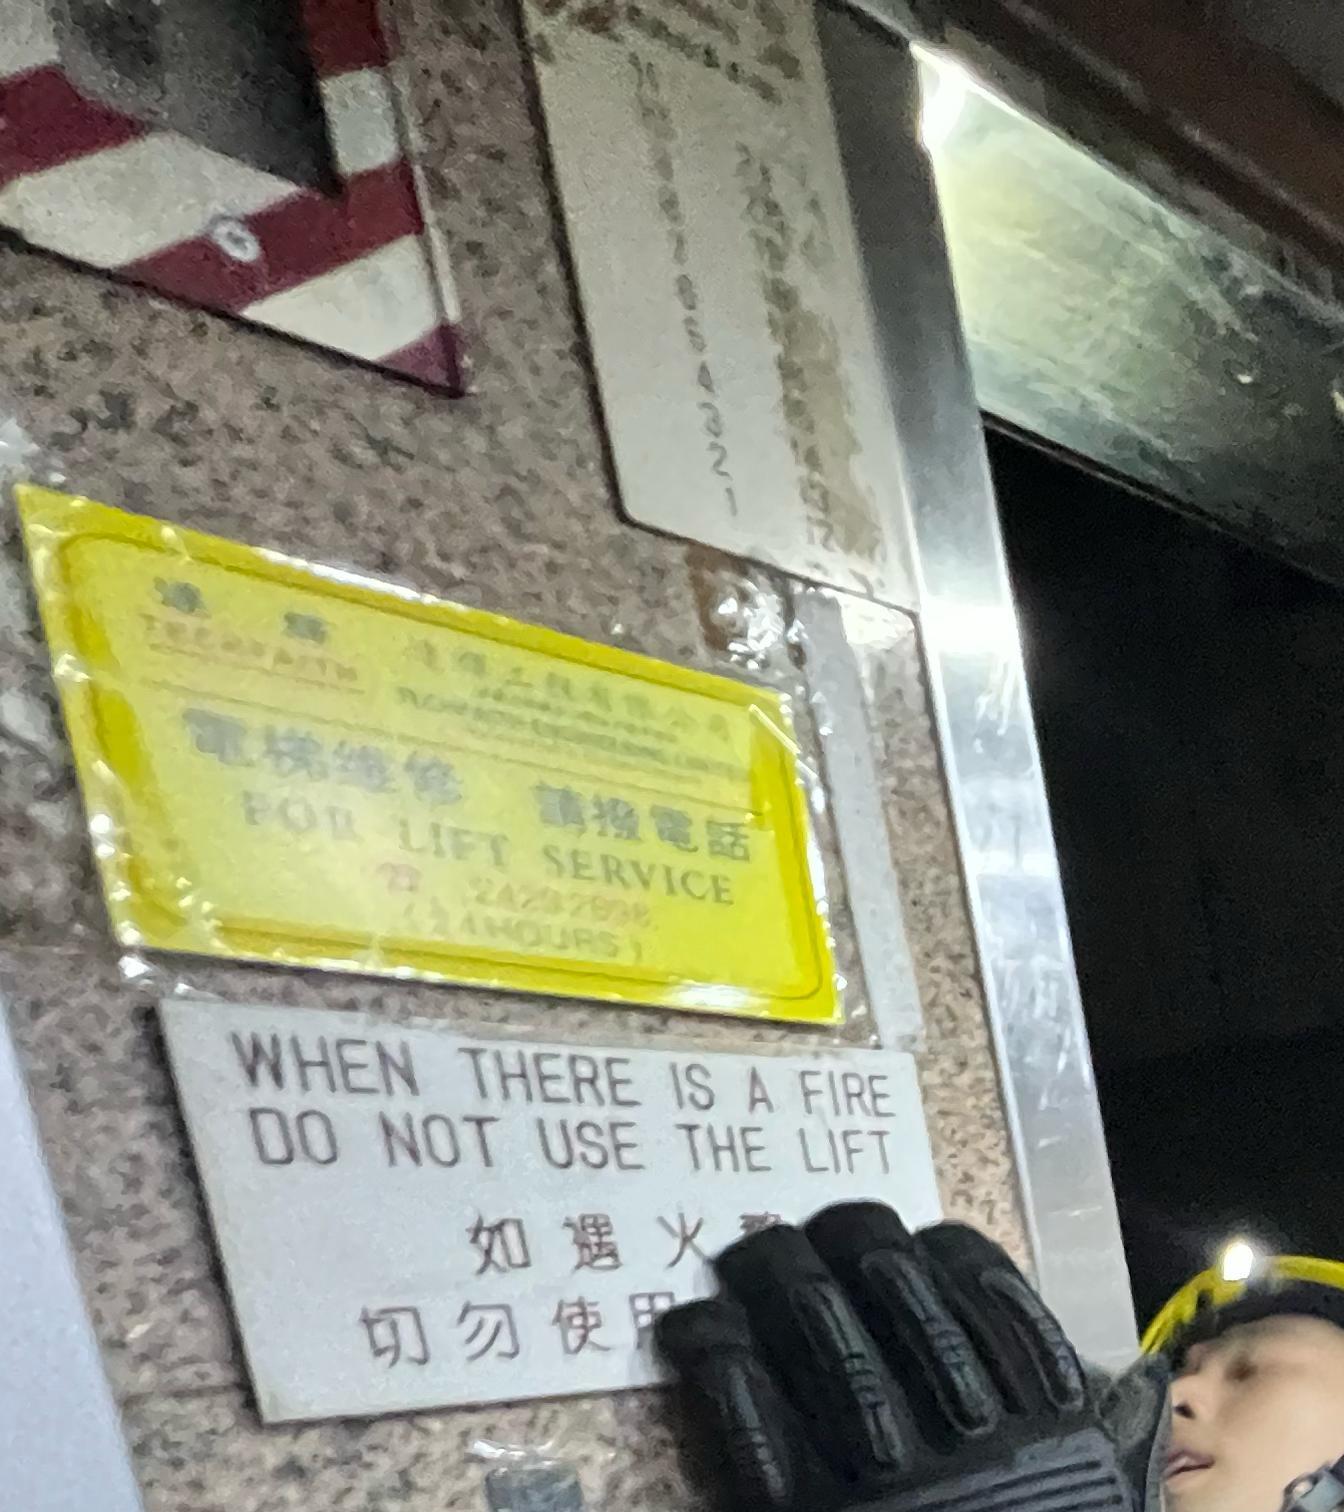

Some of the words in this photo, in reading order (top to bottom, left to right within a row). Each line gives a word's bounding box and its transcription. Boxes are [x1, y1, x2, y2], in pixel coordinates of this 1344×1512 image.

[706, 440, 733, 480] 2
[241, 789, 366, 842] FOR
[397, 816, 509, 873] LIFT
[542, 843, 735, 906] SERVICE
[231, 1031, 419, 1099] WHEN
[458, 1046, 641, 1107] THERE
[670, 1061, 717, 1111] IS
[747, 1067, 776, 1114] A
[799, 1069, 897, 1118] FIRE
[248, 1107, 340, 1167] DO
[379, 1112, 503, 1169] NOT
[538, 1120, 646, 1171] USE
[677, 1124, 769, 1173] THE
[801, 1127, 894, 1176] LIFT
[466, 1210, 785, 1278] 如遇火
